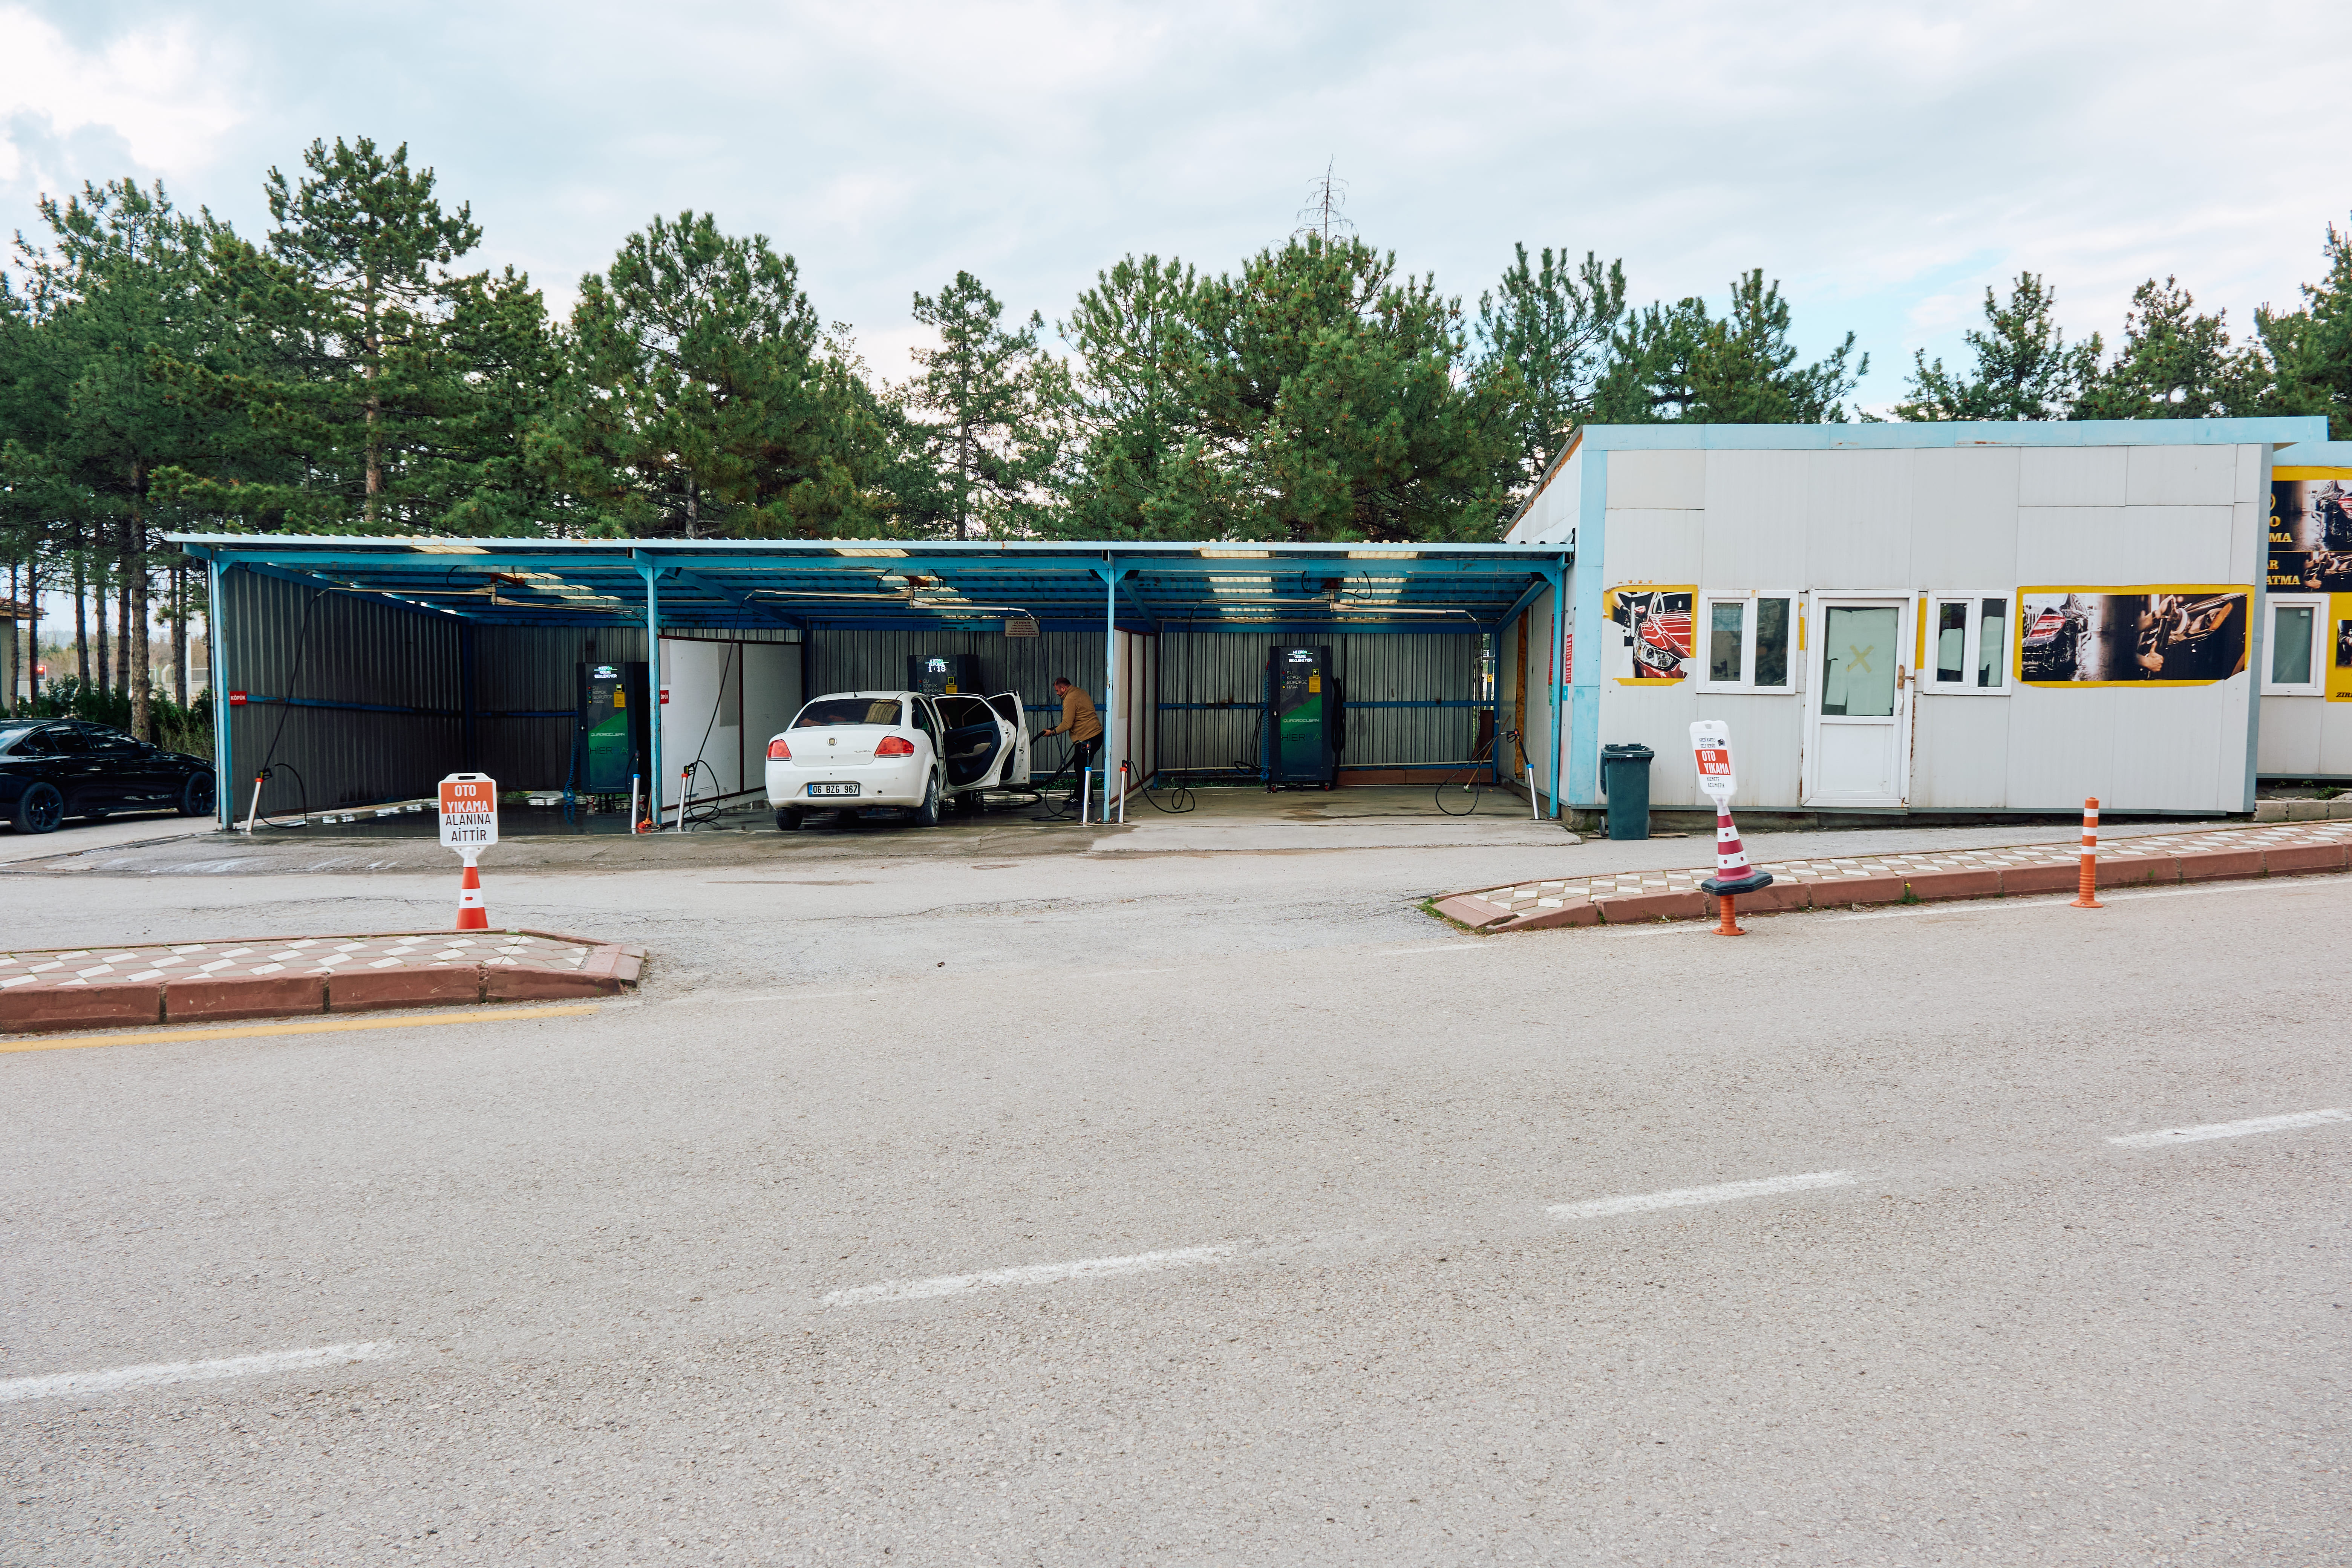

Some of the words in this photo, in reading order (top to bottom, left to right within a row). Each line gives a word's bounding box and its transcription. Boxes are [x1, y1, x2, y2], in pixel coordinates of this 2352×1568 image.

[2269, 516, 2281, 527] O
[2268, 533, 2293, 542] MA
[2266, 575, 2301, 585] ATMA
[1701, 750, 1716, 761] OTO
[1703, 763, 1730, 774] YIKAMA
[455, 785, 476, 796] OTO
[813, 785, 822, 793] 06
[826, 785, 840, 793] BZG
[844, 785, 858, 793] 967
[447, 801, 489, 813] YIKAMA
[446, 813, 491, 826] ALANINA
[451, 827, 487, 842] AİTTİR
